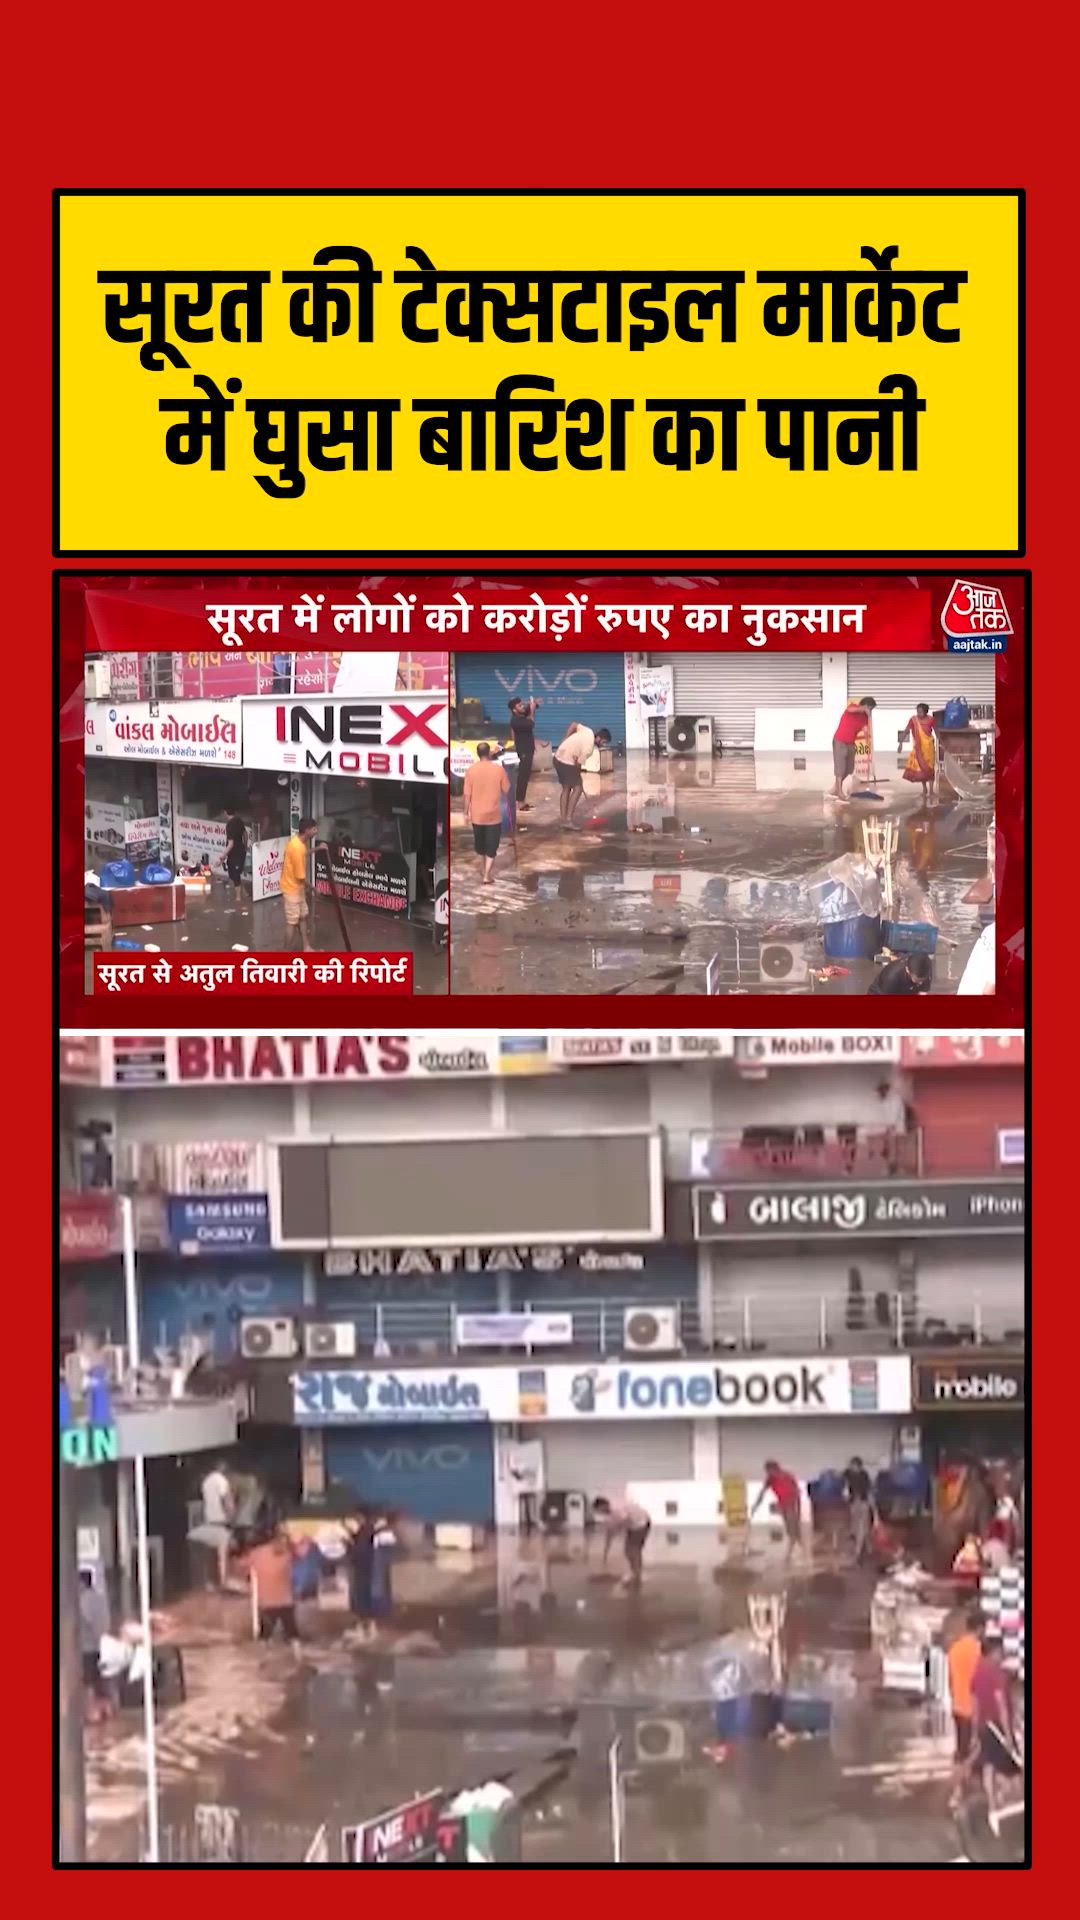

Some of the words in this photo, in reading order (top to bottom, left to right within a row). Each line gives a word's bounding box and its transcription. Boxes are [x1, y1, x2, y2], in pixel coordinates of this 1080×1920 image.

[115, 714, 155, 742] વાંકલ
[160, 714, 237, 744] મોબાઈલ
[276, 704, 448, 746] INEX
[223, 749, 236, 760] 148
[177, 1036, 410, 1080] BHATIA'S
[771, 1036, 834, 1055] Mobile
[184, 1201, 267, 1220] SAMSUNG
[749, 1193, 867, 1229] બાલાજી
[196, 1225, 257, 1243] Galaxy
[325, 1246, 565, 1277] BHATIA'S
[616, 1365, 827, 1411] fonebook
